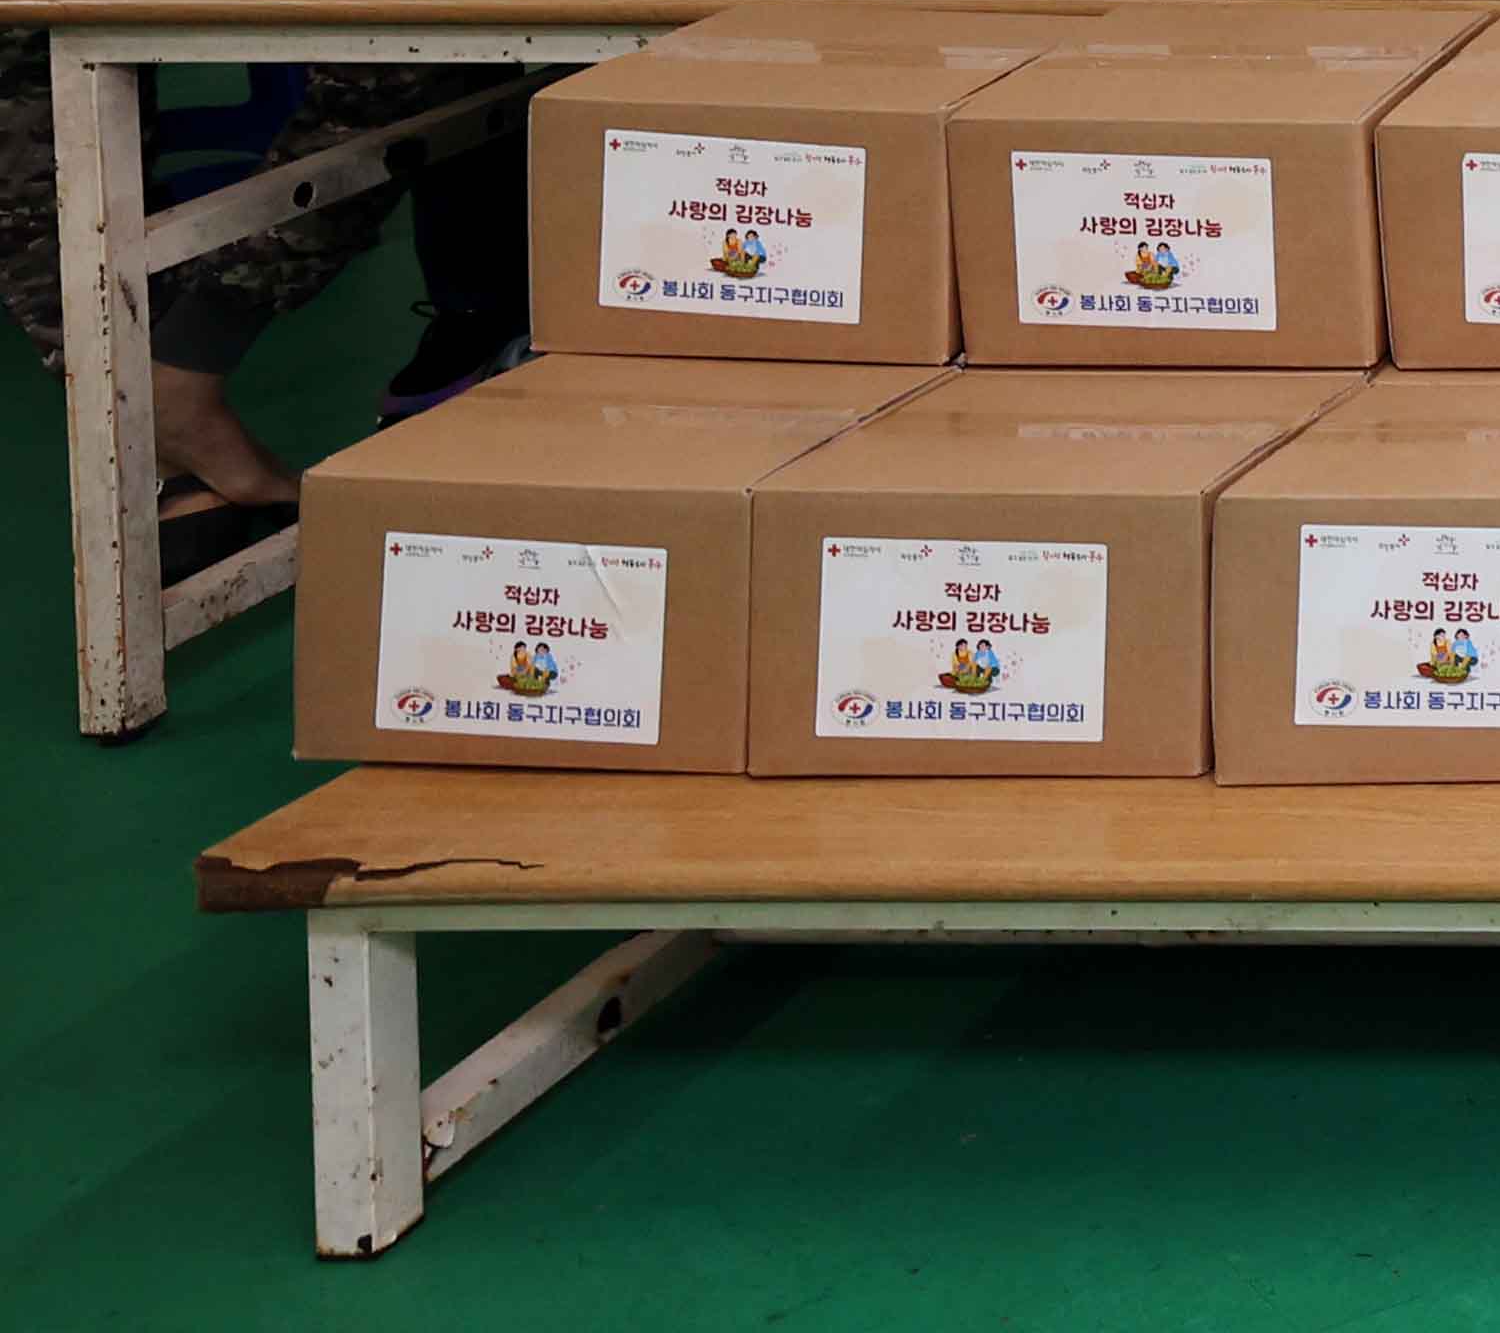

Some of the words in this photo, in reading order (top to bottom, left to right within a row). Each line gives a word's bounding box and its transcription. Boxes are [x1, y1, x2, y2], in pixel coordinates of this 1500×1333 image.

[715, 177, 769, 200] 적십자
[667, 198, 729, 223] 사랑의
[733, 203, 813, 230] 김장나눔
[943, 582, 1002, 605] 적십자
[1421, 571, 1480, 593] 적십자
[503, 584, 562, 608] 적십자
[1369, 598, 1435, 622] 사랑의
[452, 608, 518, 635] 사랑의
[524, 613, 610, 641] 김장나눔
[892, 609, 958, 634] 사랑의
[964, 611, 1052, 636] 김장나눔
[884, 698, 944, 722] 봉사회
[948, 700, 1086, 726] 동구지구협의회
[1362, 688, 1422, 712] 봉사회
[443, 696, 502, 722] 봉사회
[506, 700, 643, 731] 동구지구협의회
